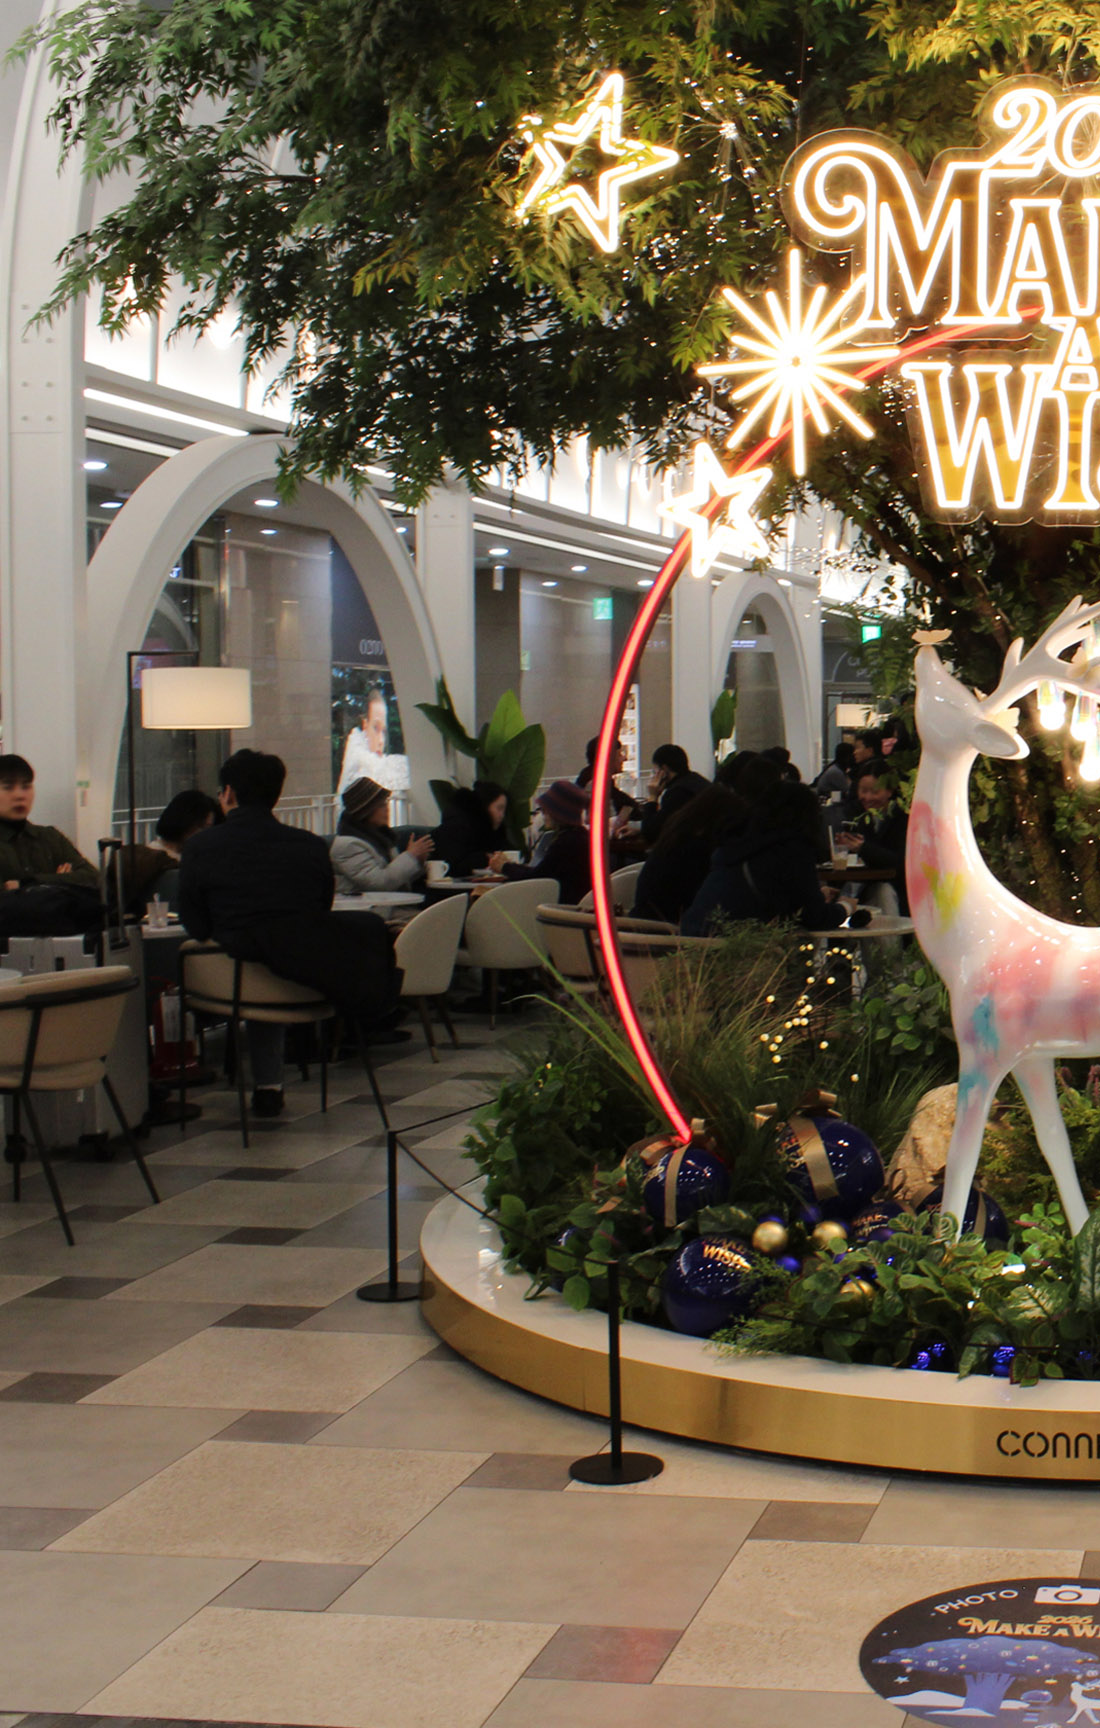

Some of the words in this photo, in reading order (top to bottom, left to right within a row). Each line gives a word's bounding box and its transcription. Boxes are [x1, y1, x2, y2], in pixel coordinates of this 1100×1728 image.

[934, 1589, 1019, 1614] PHOTO
[957, 1616, 1052, 1637] MAKE
[1052, 1628, 1069, 1637] A
[1036, 1614, 1094, 1625] 2026
